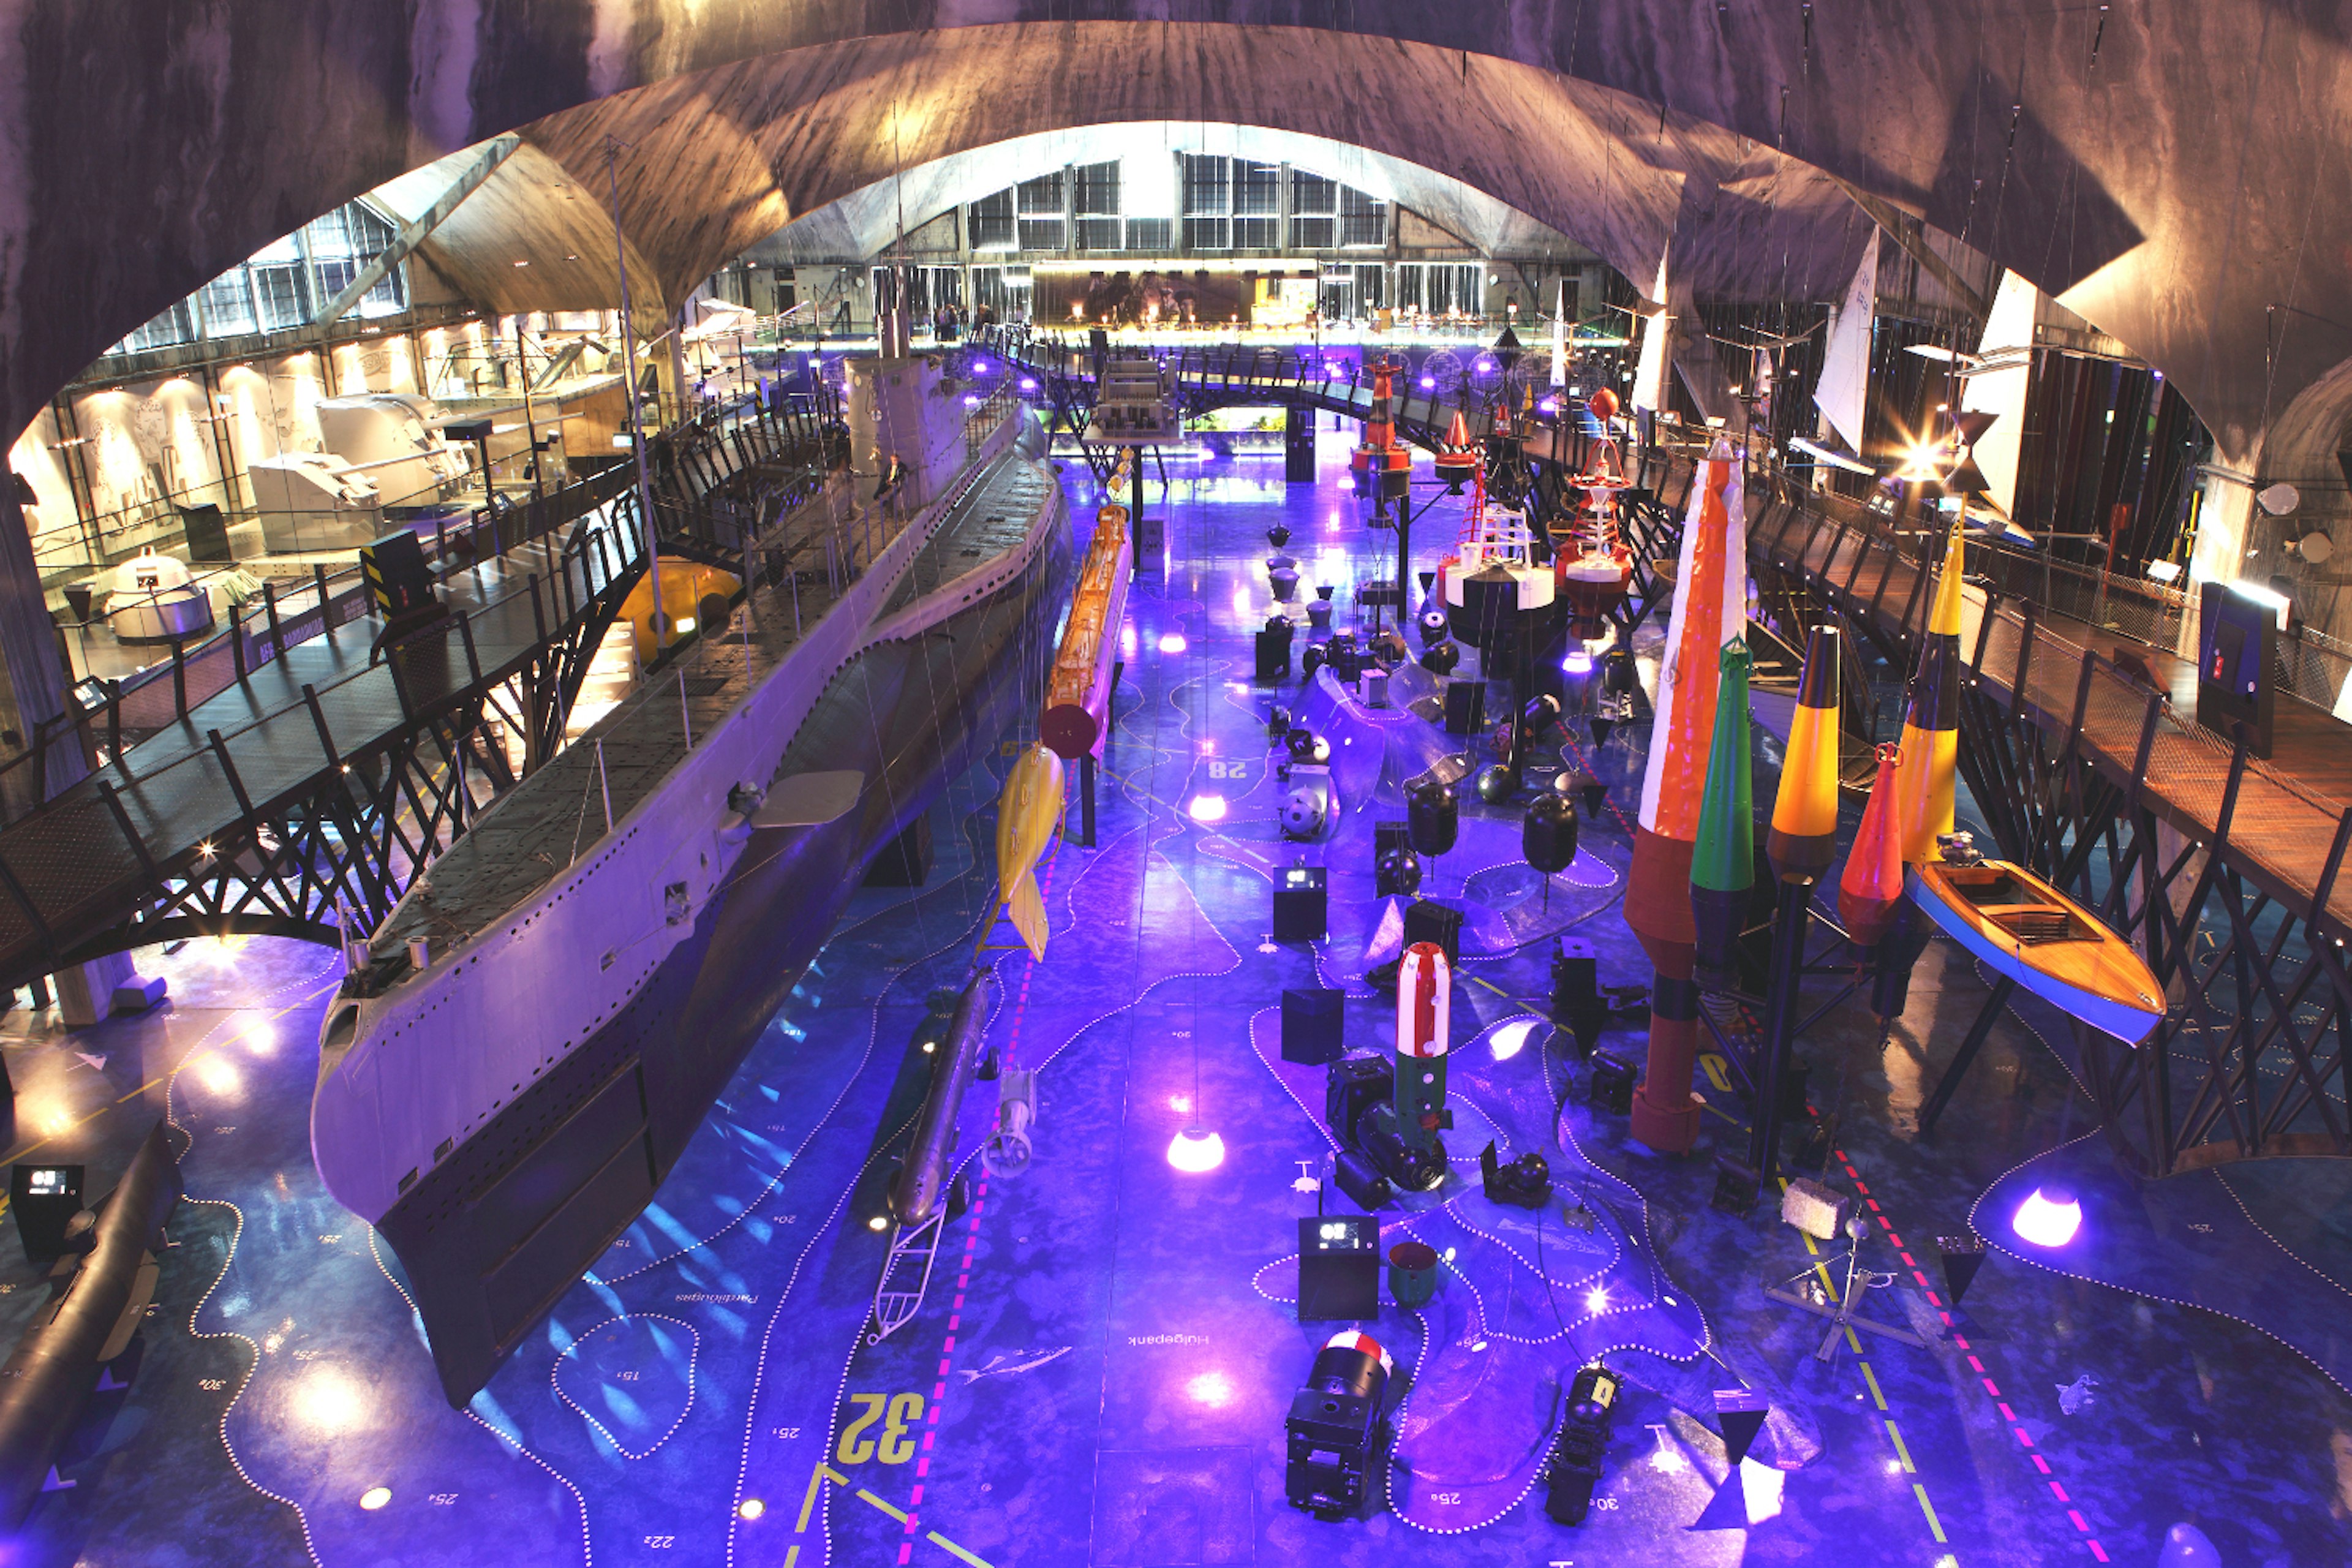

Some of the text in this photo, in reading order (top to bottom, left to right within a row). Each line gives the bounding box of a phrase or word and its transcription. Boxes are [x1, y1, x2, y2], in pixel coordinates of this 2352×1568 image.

[1208, 761, 1246, 778] 28
[1128, 1334, 1210, 1348] Hülgepank
[773, 1428, 801, 1439] 251
[836, 1393, 925, 1464] 32
